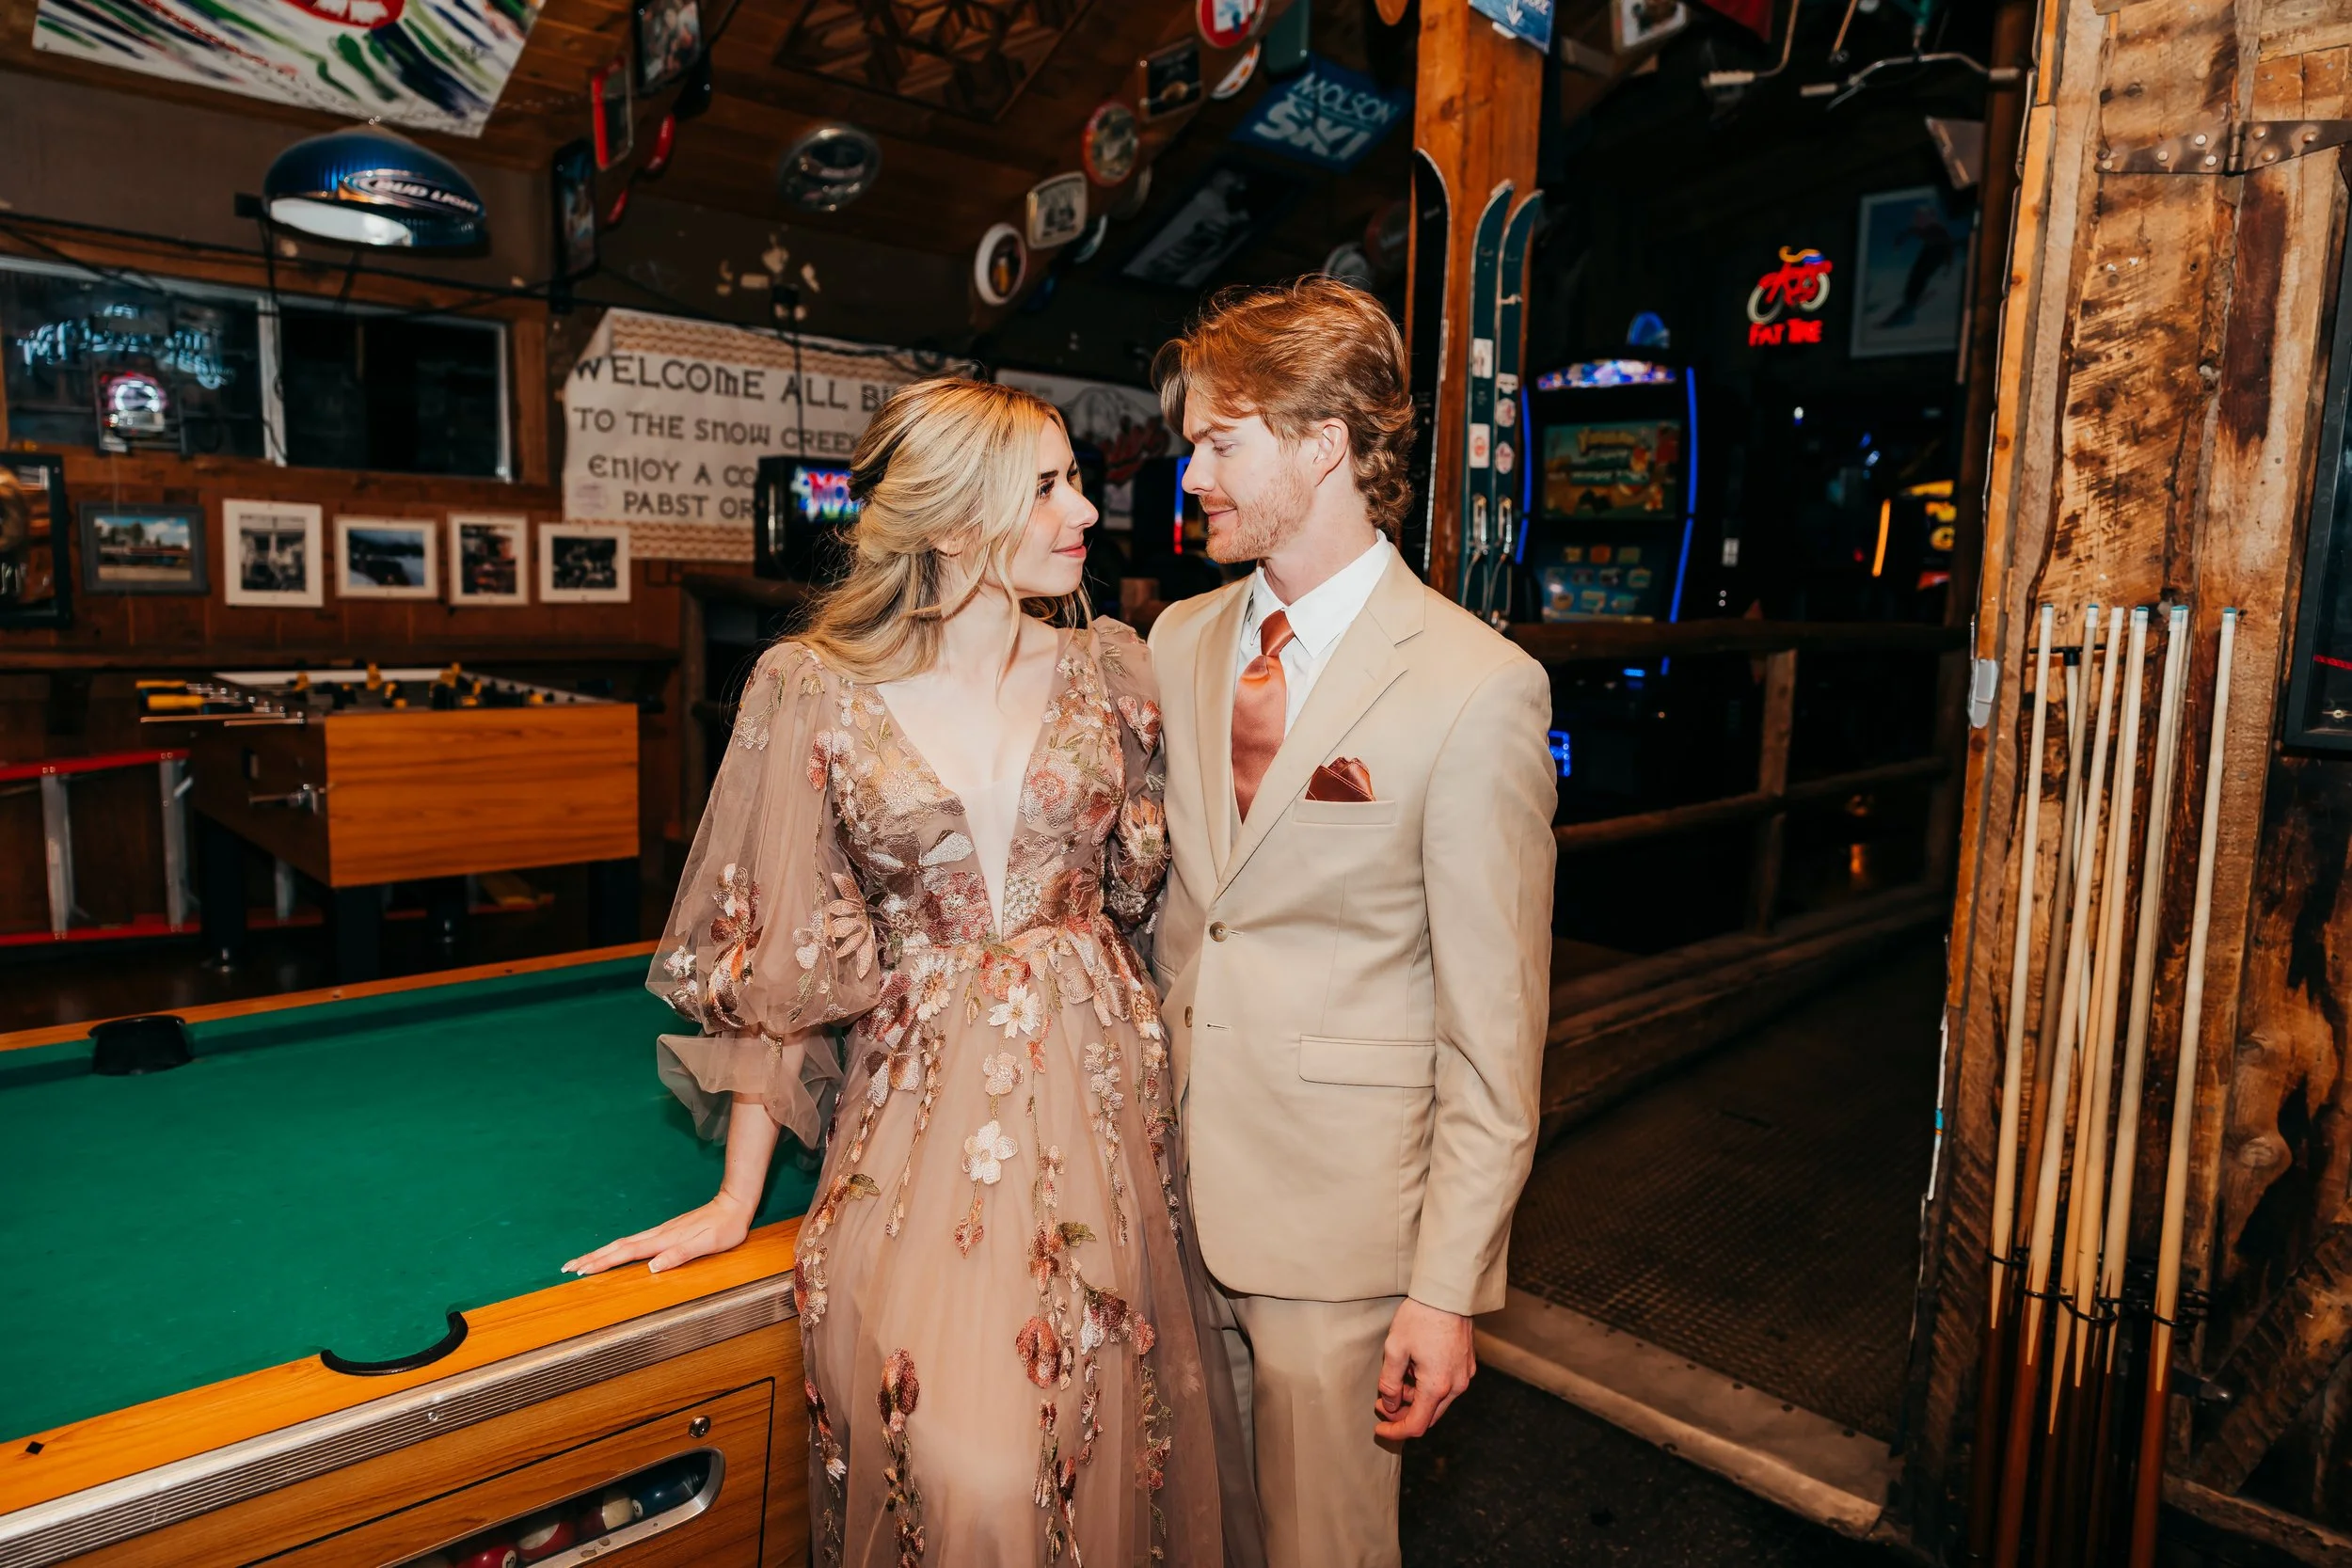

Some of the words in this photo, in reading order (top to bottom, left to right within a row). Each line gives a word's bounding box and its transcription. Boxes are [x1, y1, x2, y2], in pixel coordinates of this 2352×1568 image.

[1292, 71, 1398, 124] MOLSON
[1252, 97, 1372, 160] SKI
[1747, 322, 1786, 348] FAT
[574, 355, 765, 401] WELCOME
[780, 375, 849, 410] ALL
[572, 406, 616, 433] TO
[626, 410, 685, 440] THE
[694, 417, 771, 447] SNOW
[588, 454, 680, 485] ENJOY
[692, 464, 712, 486] A
[623, 490, 708, 518] PABST
